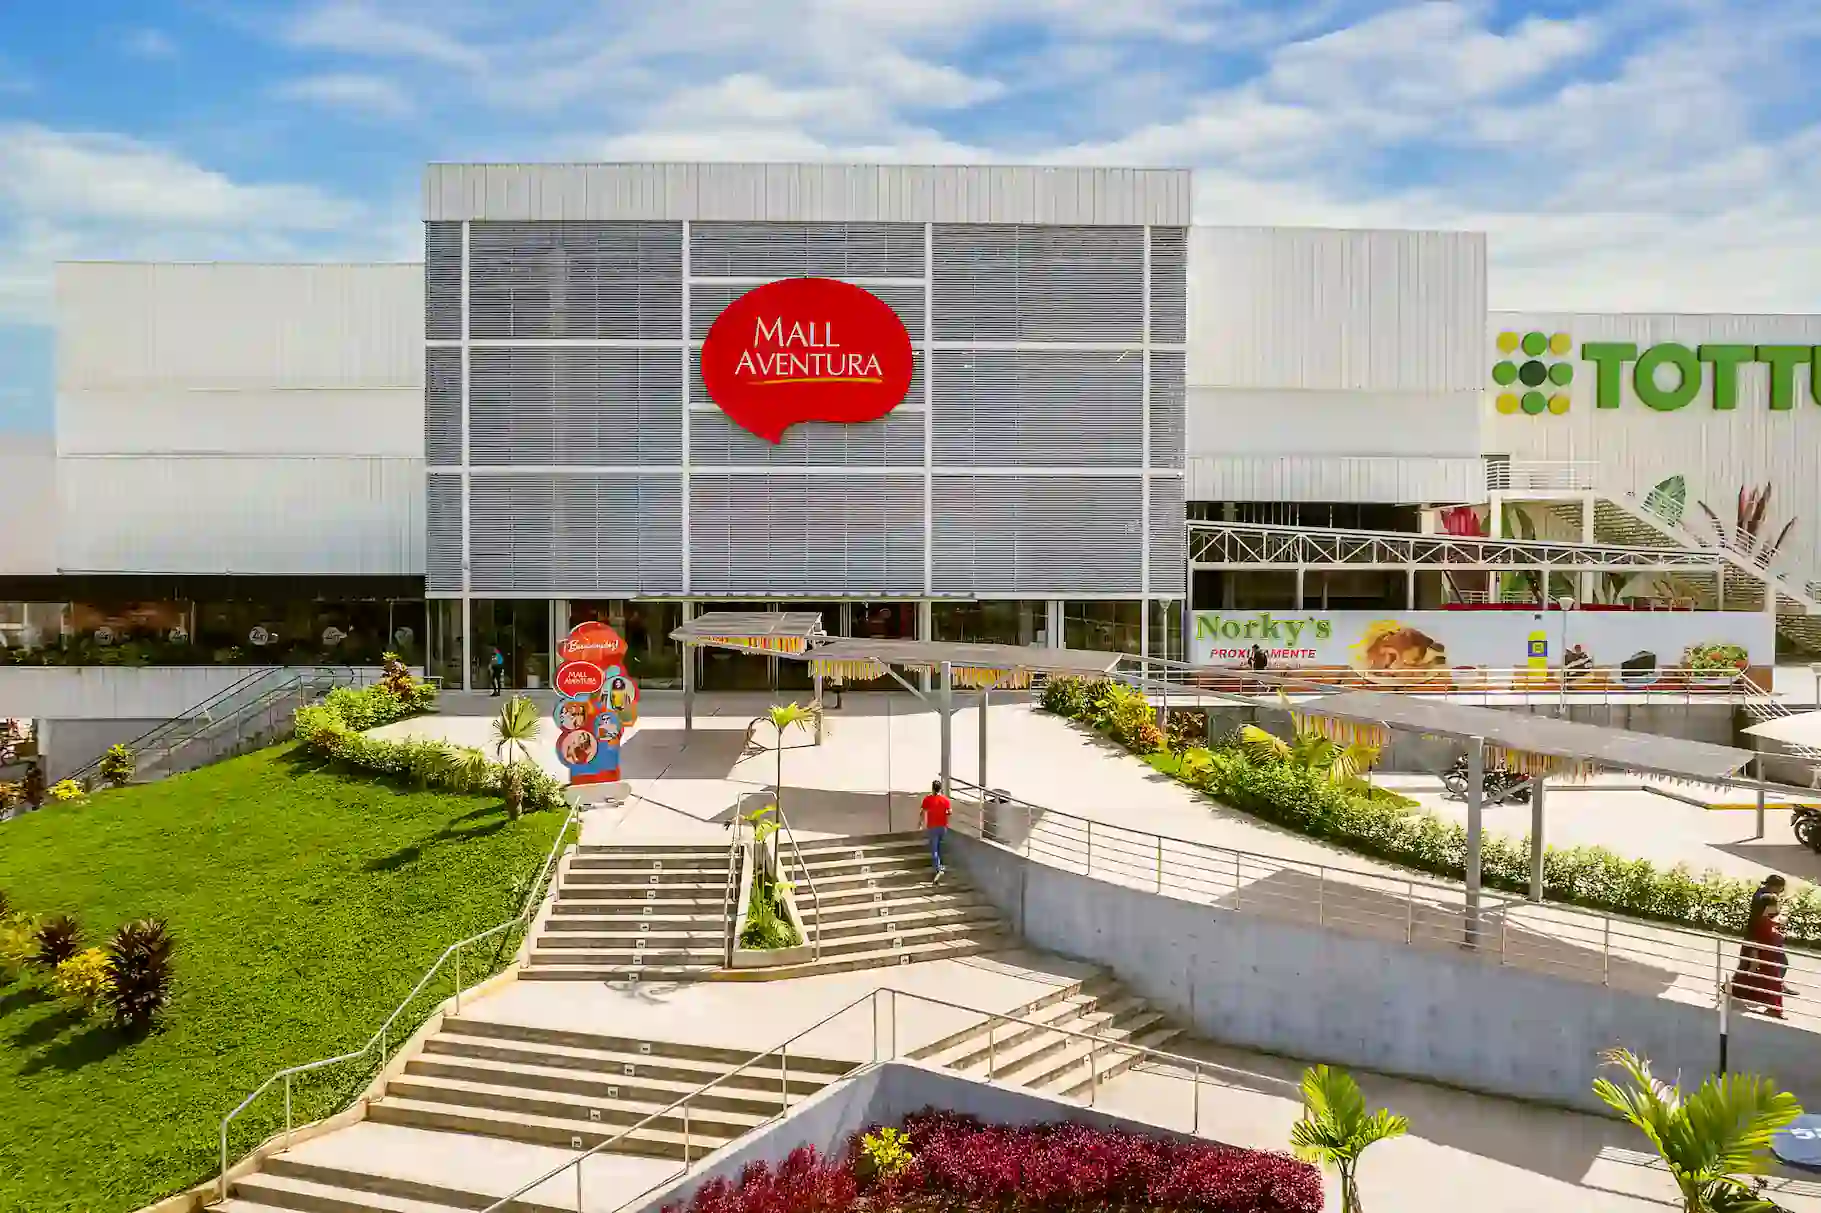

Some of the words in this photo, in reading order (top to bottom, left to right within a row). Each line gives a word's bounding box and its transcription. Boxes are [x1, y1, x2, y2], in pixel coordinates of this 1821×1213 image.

[754, 316, 840, 348] MALL
[734, 349, 883, 376] AVENTURA
[1582, 342, 1821, 411] TOTT
[1195, 611, 1333, 647] Norky's
[1210, 649, 1317, 660] PROXIMENTE
